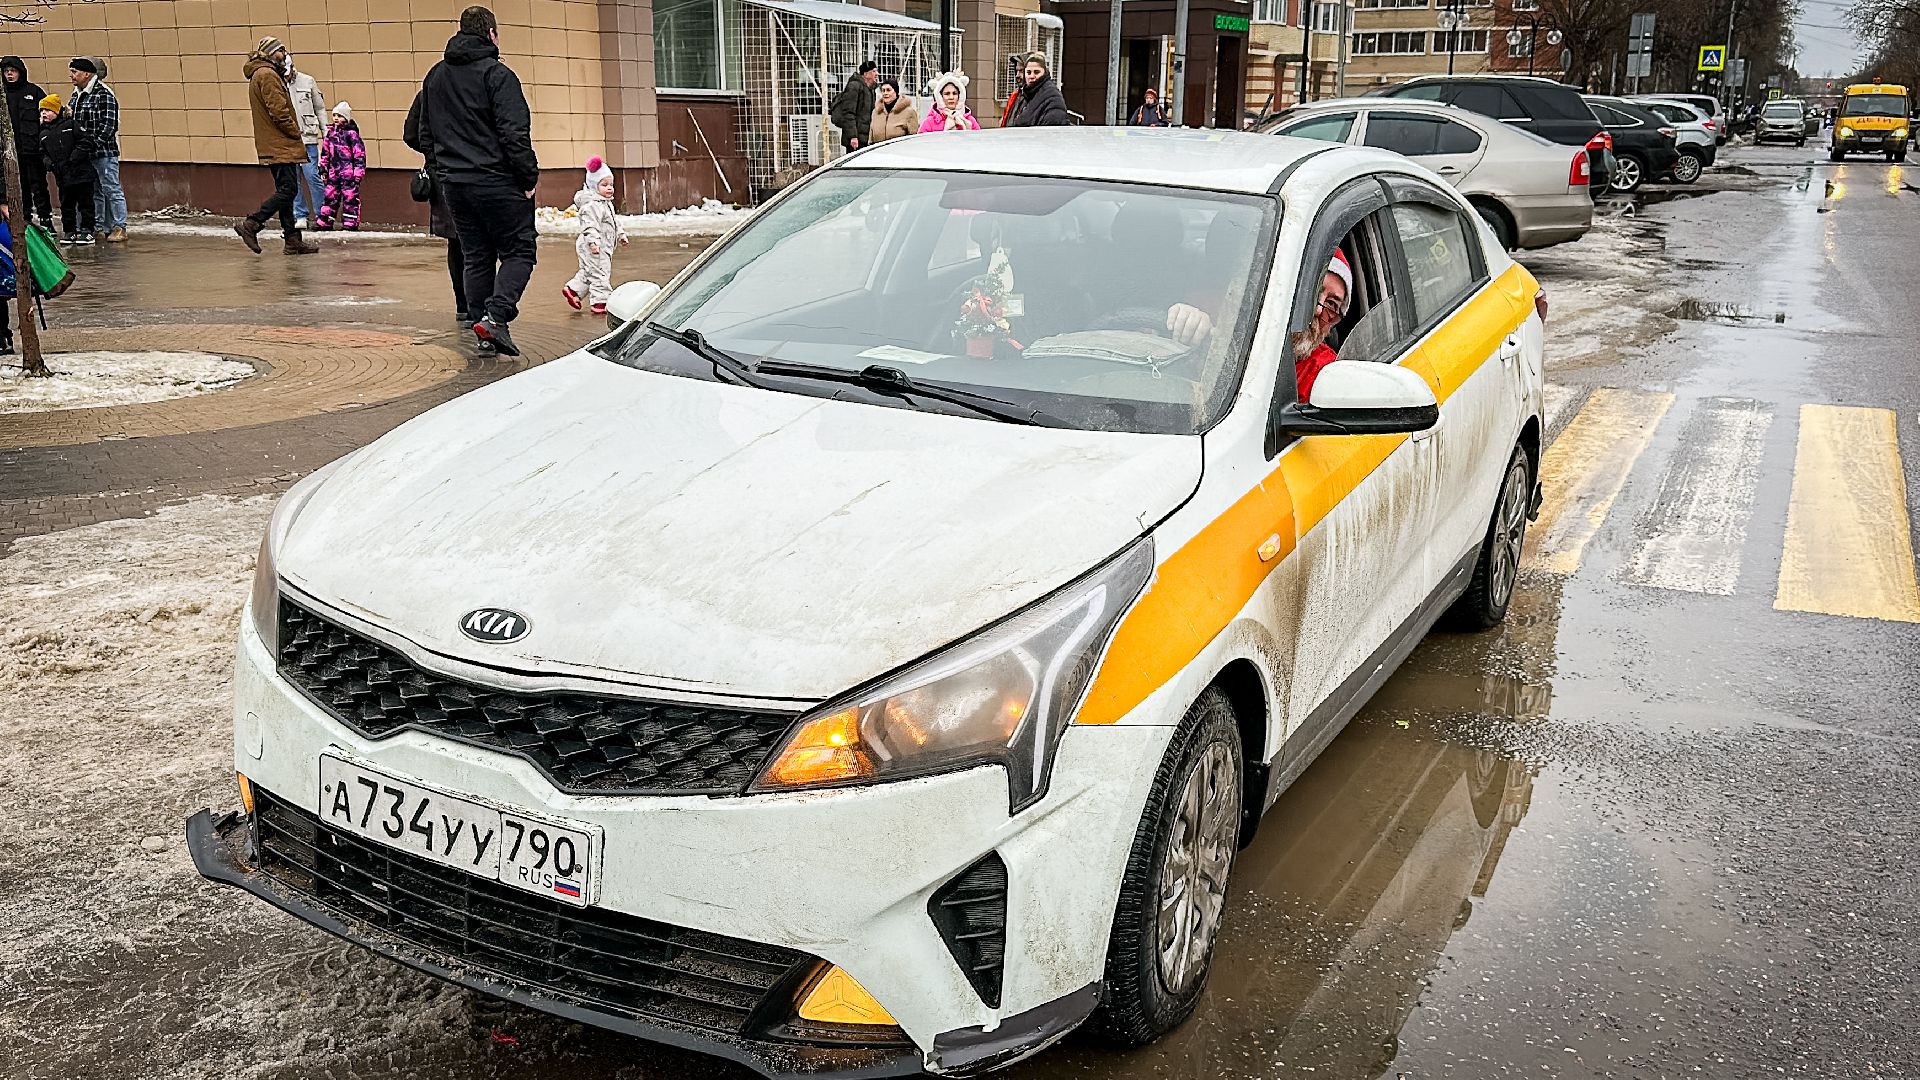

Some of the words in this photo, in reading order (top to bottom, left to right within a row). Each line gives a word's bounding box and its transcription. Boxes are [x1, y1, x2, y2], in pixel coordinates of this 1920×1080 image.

[465, 610, 517, 638] KIA
[331, 775, 494, 865] А734УУ
[505, 820, 576, 878] 790
[518, 866, 553, 889] RUS
